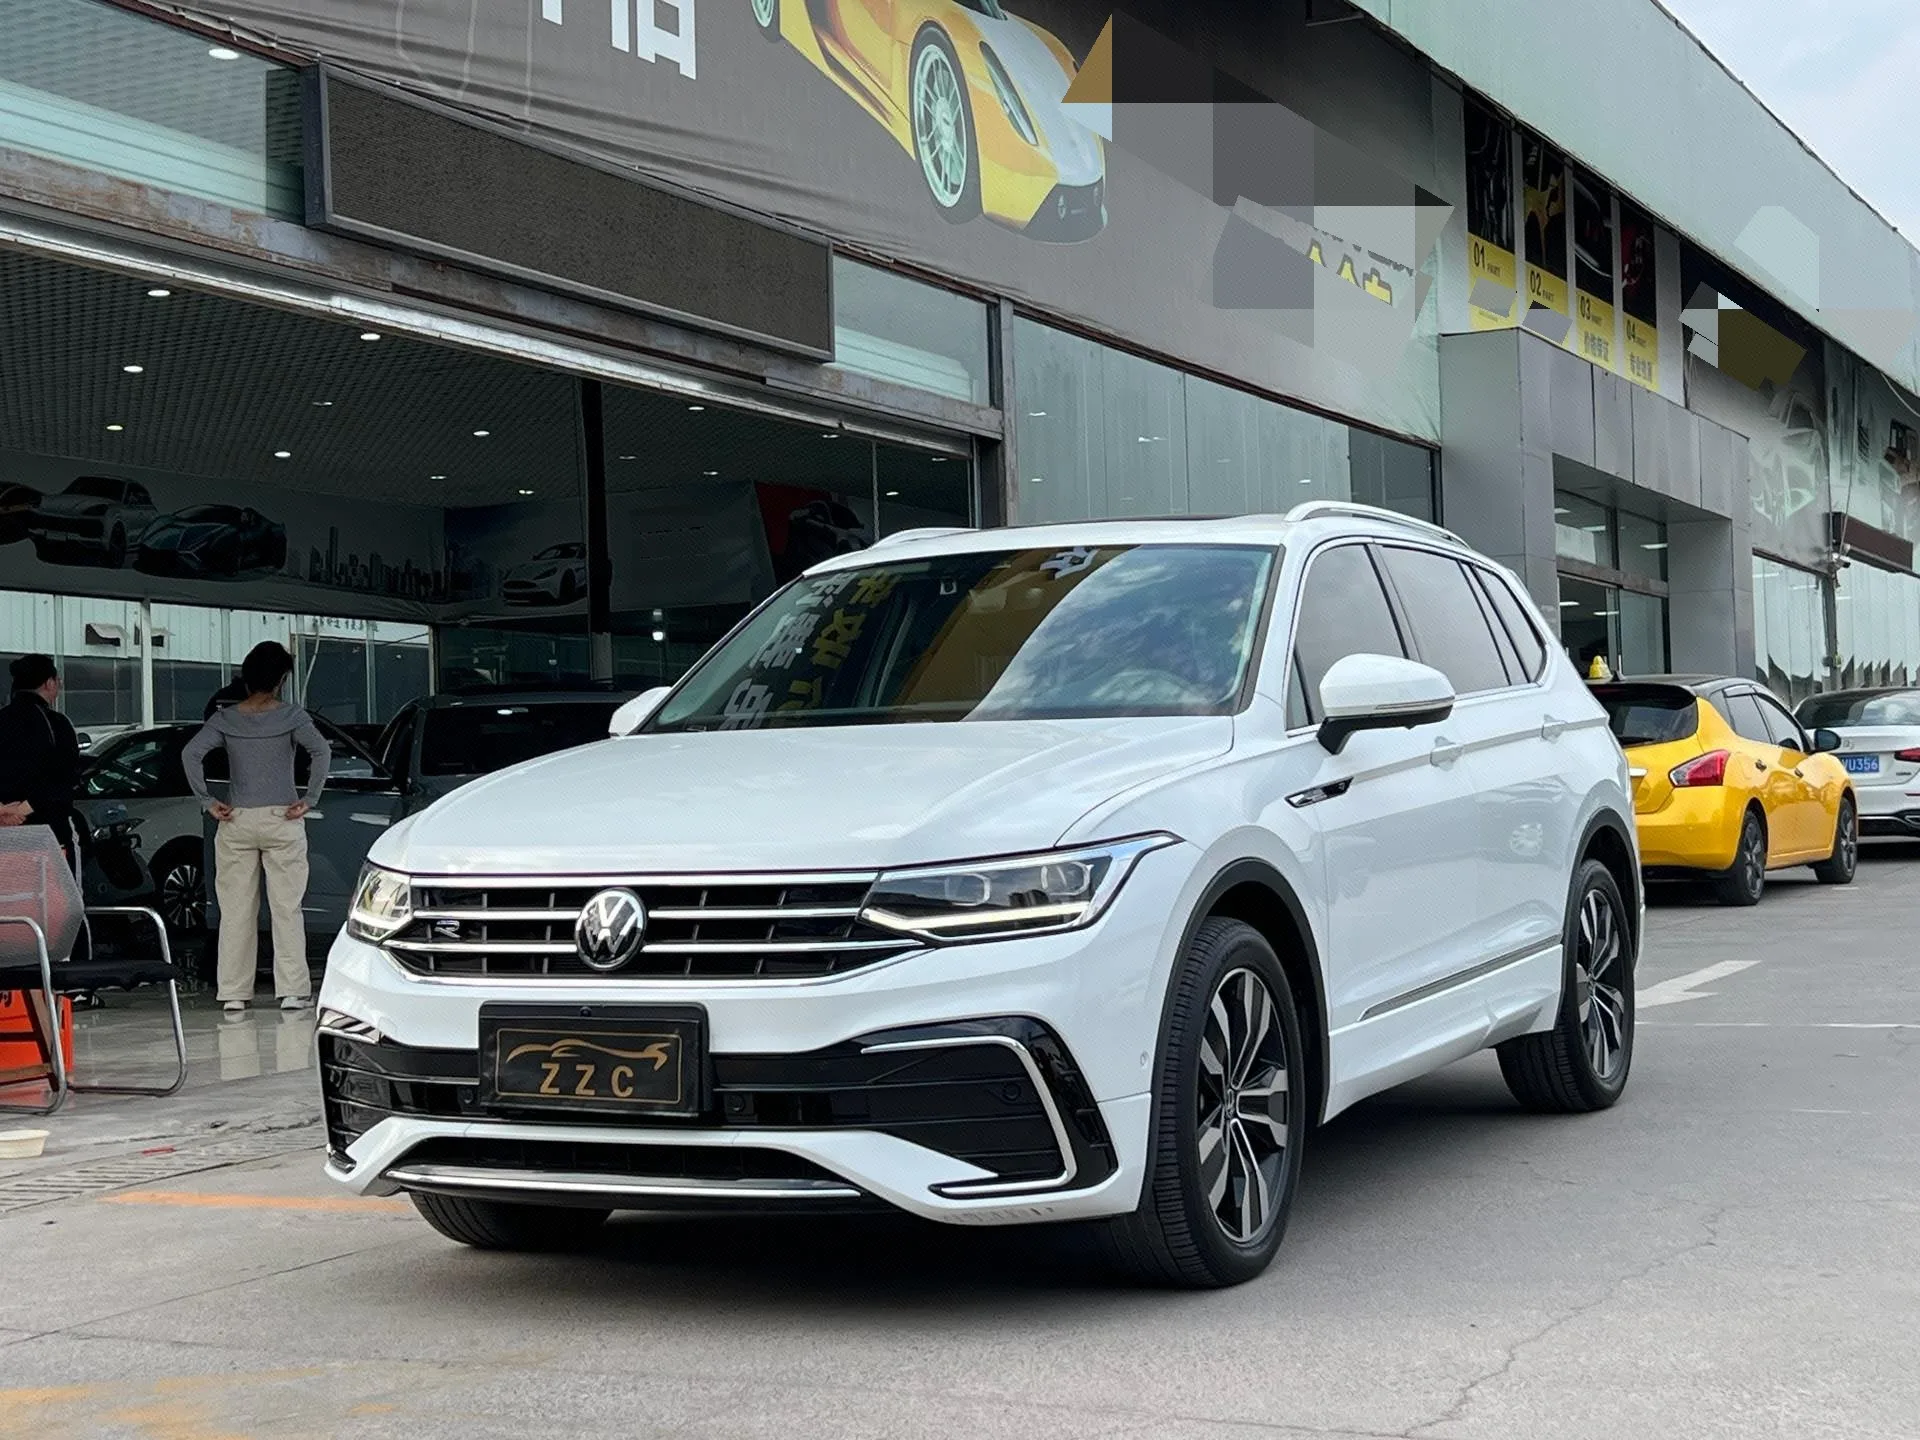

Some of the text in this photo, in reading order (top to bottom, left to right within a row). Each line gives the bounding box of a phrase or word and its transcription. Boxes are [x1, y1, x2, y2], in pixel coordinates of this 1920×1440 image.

[1473, 241, 1485, 270] 01
[1530, 269, 1542, 297] 02
[1580, 296, 1591, 320] 03
[1626, 319, 1636, 342] 04
